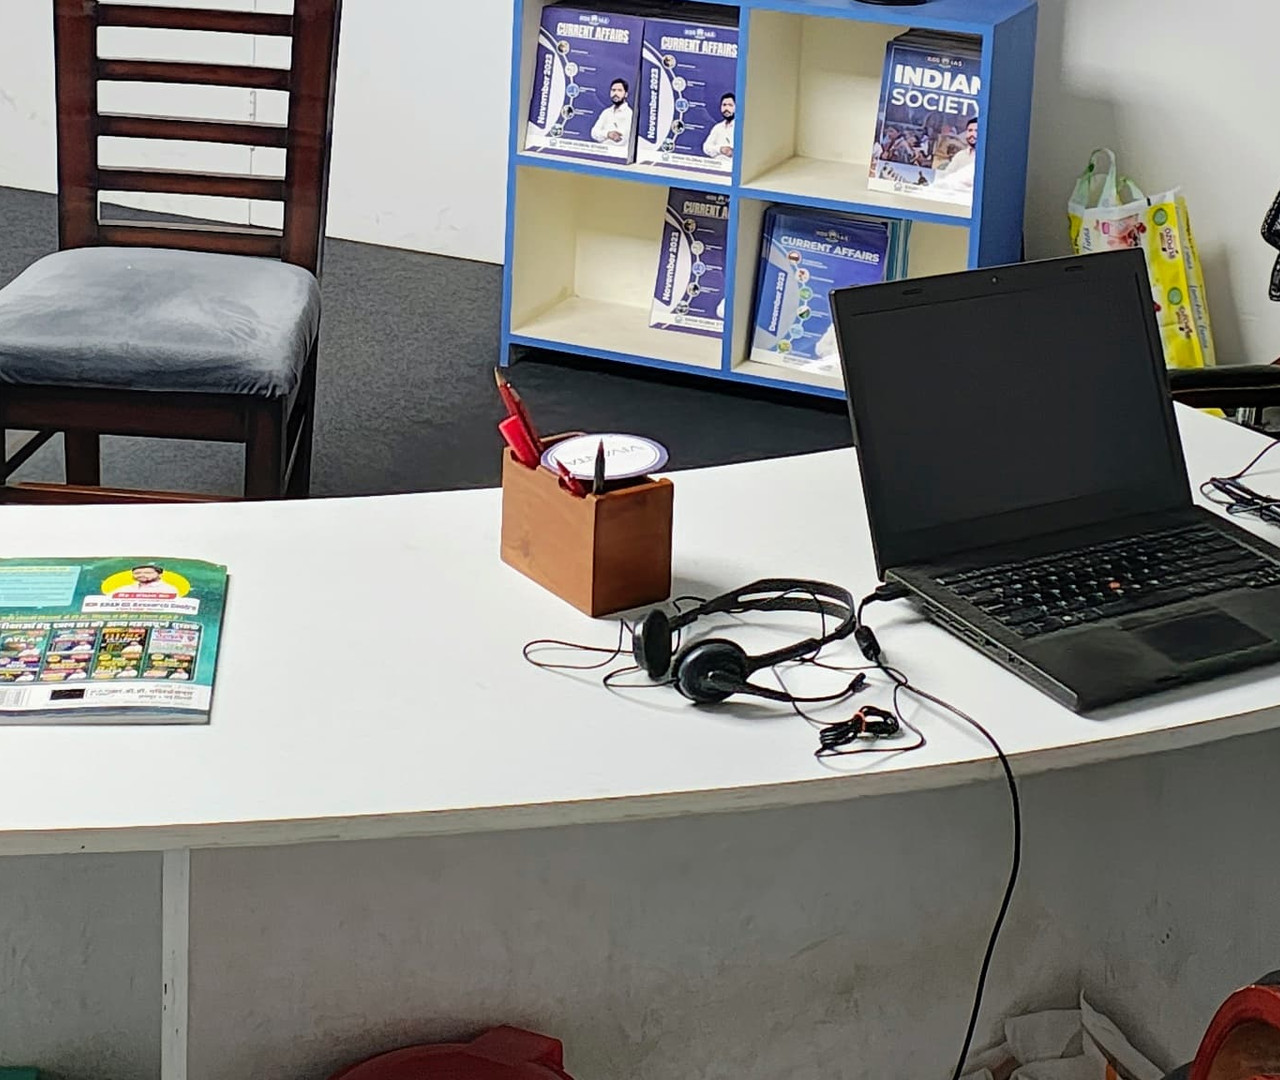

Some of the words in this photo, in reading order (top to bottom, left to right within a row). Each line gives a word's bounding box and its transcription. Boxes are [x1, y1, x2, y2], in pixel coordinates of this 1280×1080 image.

[556, 22, 594, 39] CURRENT
[595, 27, 630, 44] AFFAIRS
[661, 36, 700, 54] CURRENT
[701, 41, 738, 58] AFFAIRS
[537, 78, 551, 124] November
[647, 91, 658, 139] November
[683, 201, 720, 218] CURRENT
[781, 236, 832, 252] CURRENT
[834, 246, 880, 263] AFFAIRS
[662, 256, 676, 301] November
